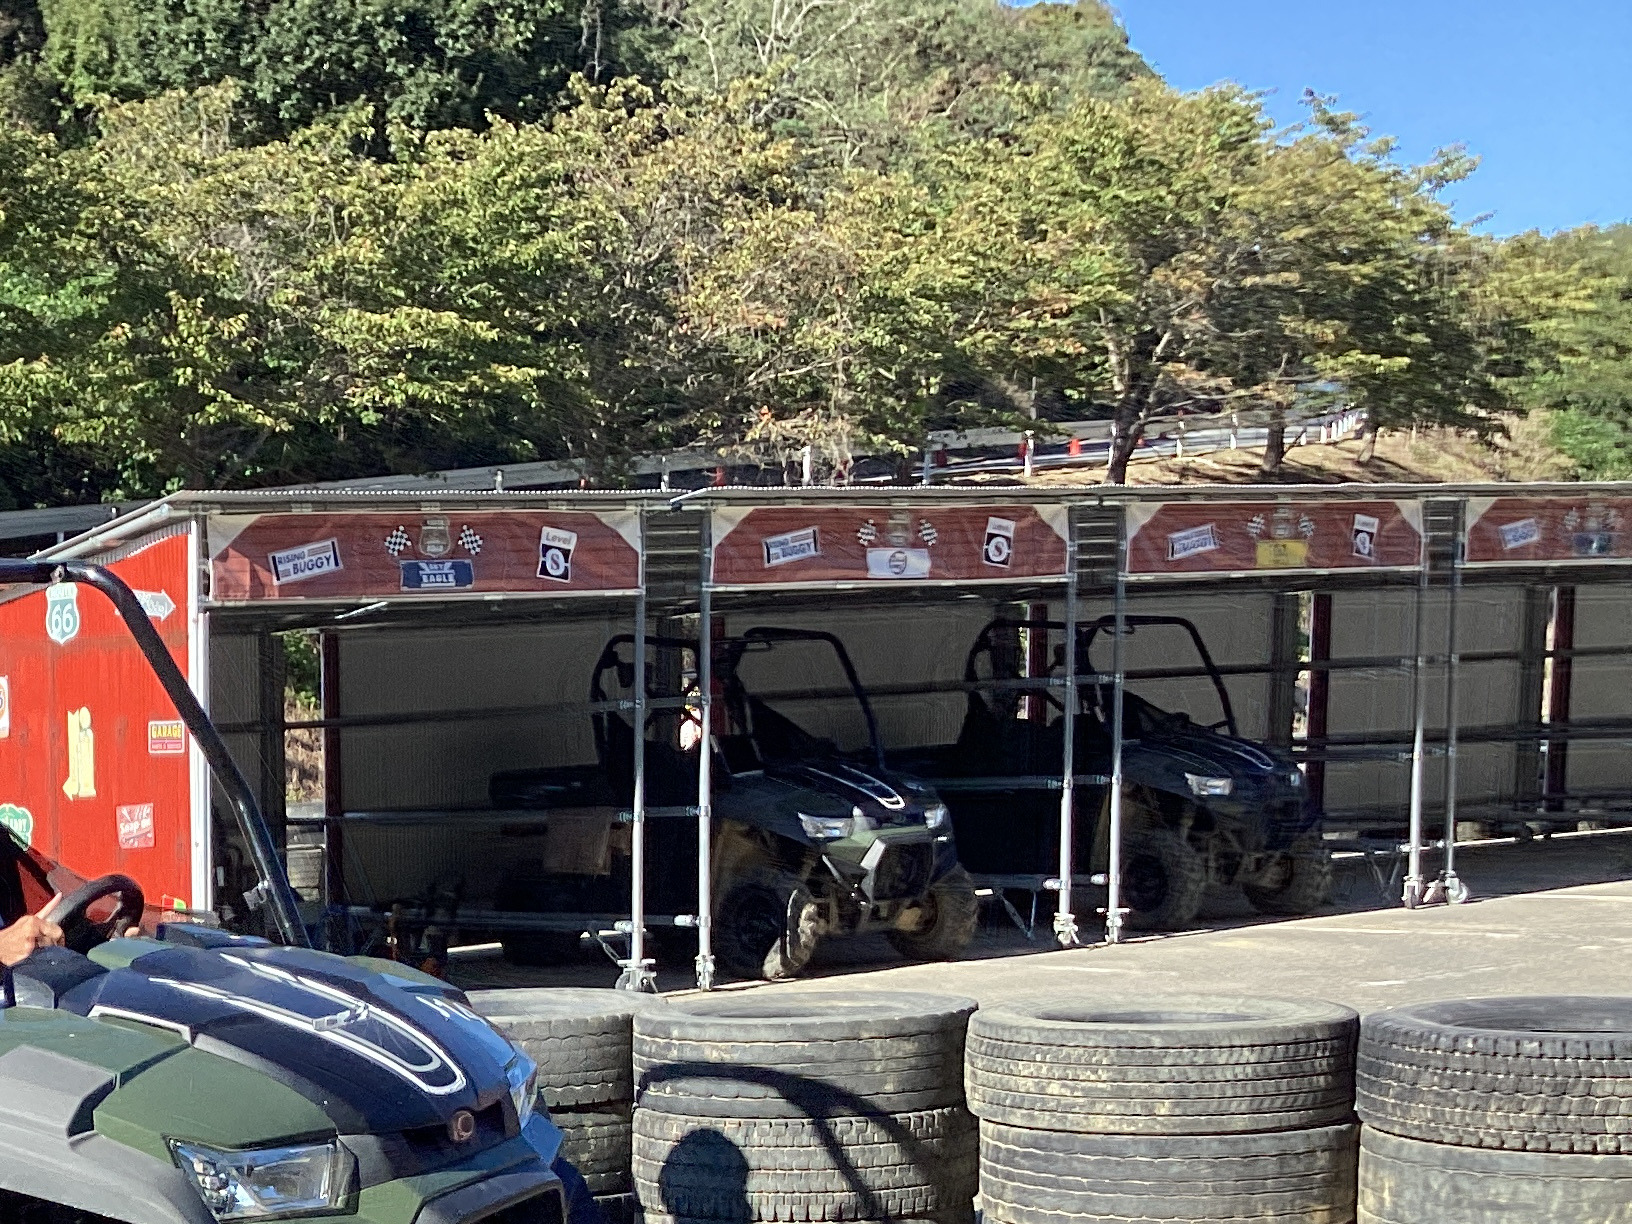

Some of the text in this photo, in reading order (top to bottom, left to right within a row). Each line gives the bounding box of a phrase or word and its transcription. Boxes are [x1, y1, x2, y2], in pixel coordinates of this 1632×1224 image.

[292, 555, 332, 575] BUGGY
[51, 603, 74, 634] 66
[151, 724, 182, 739] GARAGE
